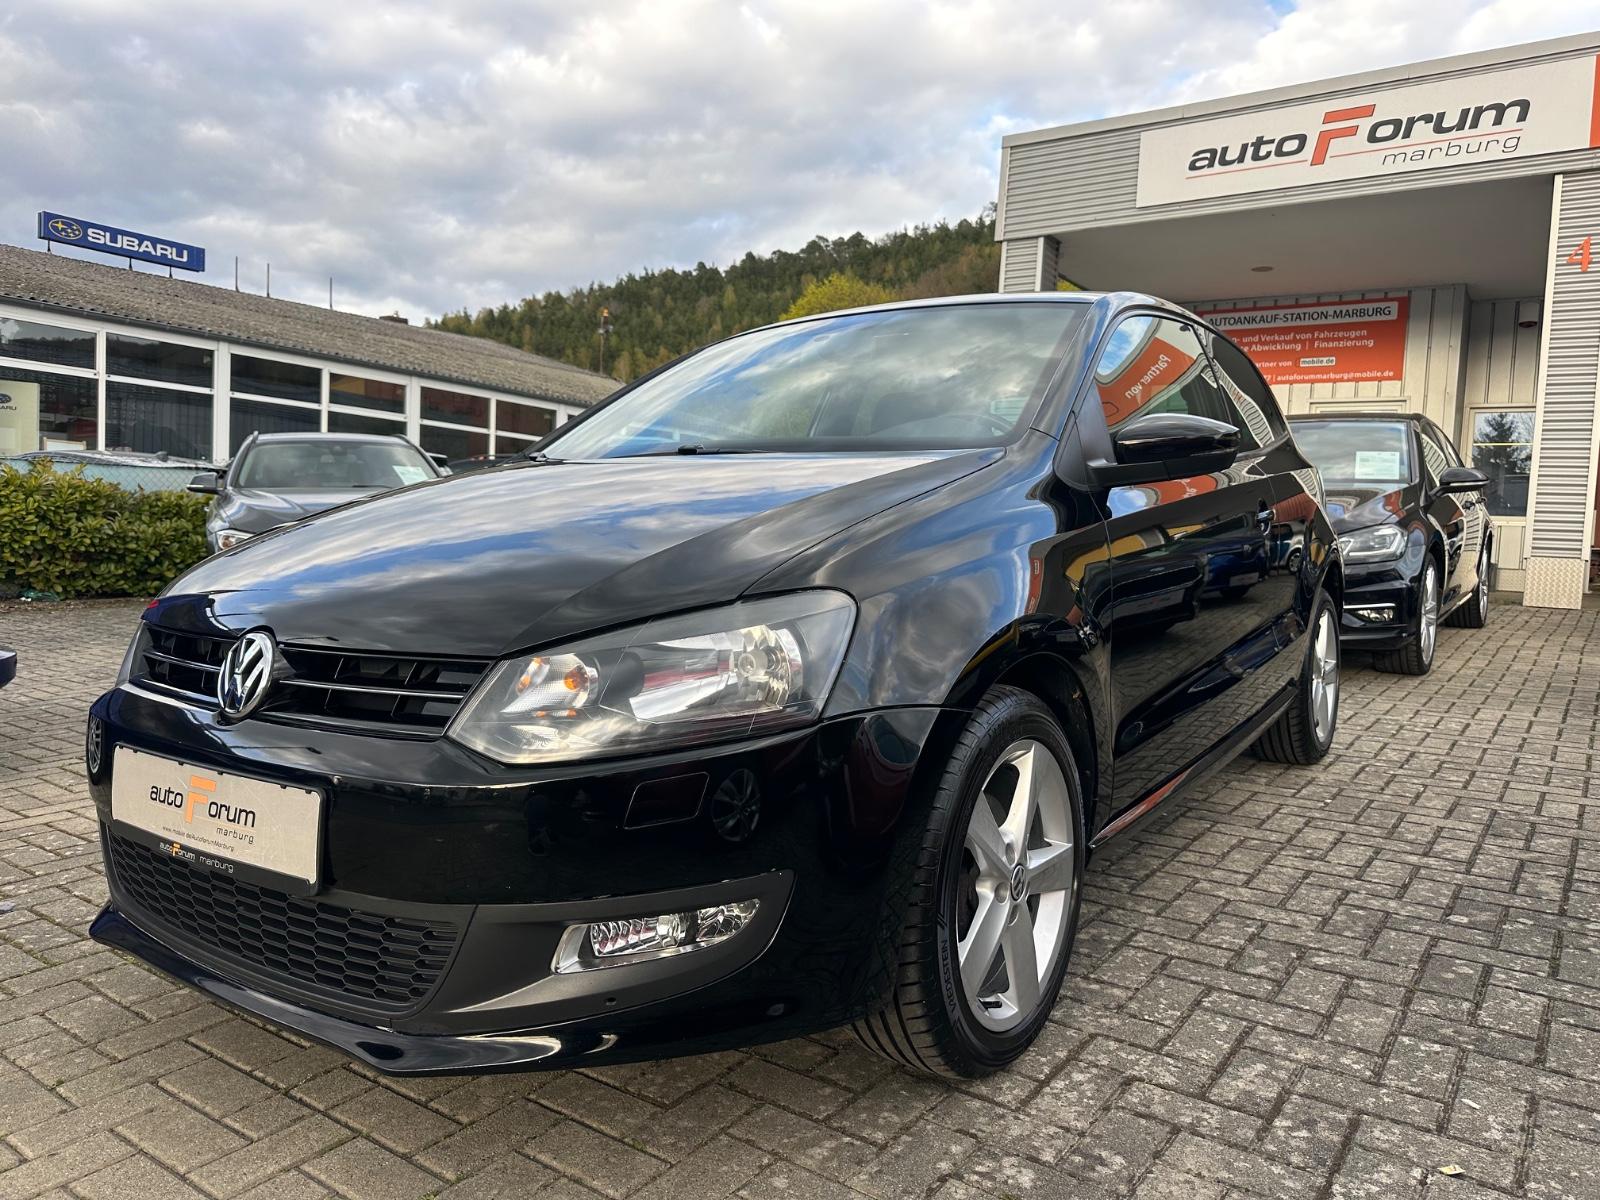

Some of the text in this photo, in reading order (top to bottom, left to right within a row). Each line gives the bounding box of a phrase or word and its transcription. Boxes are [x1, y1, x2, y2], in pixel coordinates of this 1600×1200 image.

[1381, 134, 1522, 166] marburg
[87, 228, 188, 263] SUBARU
[1566, 235, 1593, 273] 4
[1209, 306, 1391, 326] AUTOANKAUF-STATION-MARBURG
[1242, 335, 1259, 343] und
[1260, 332, 1294, 342] Verkauf
[1295, 332, 1312, 340] von
[1314, 329, 1367, 339] Fahrzeugen
[1250, 342, 1301, 352] Abwicklung
[1314, 339, 1374, 348] Finanzierung
[1276, 370, 1394, 380] autoforummarburg@mobile.de
[215, 826, 254, 844] marburg
[199, 856, 234, 874] marburg
